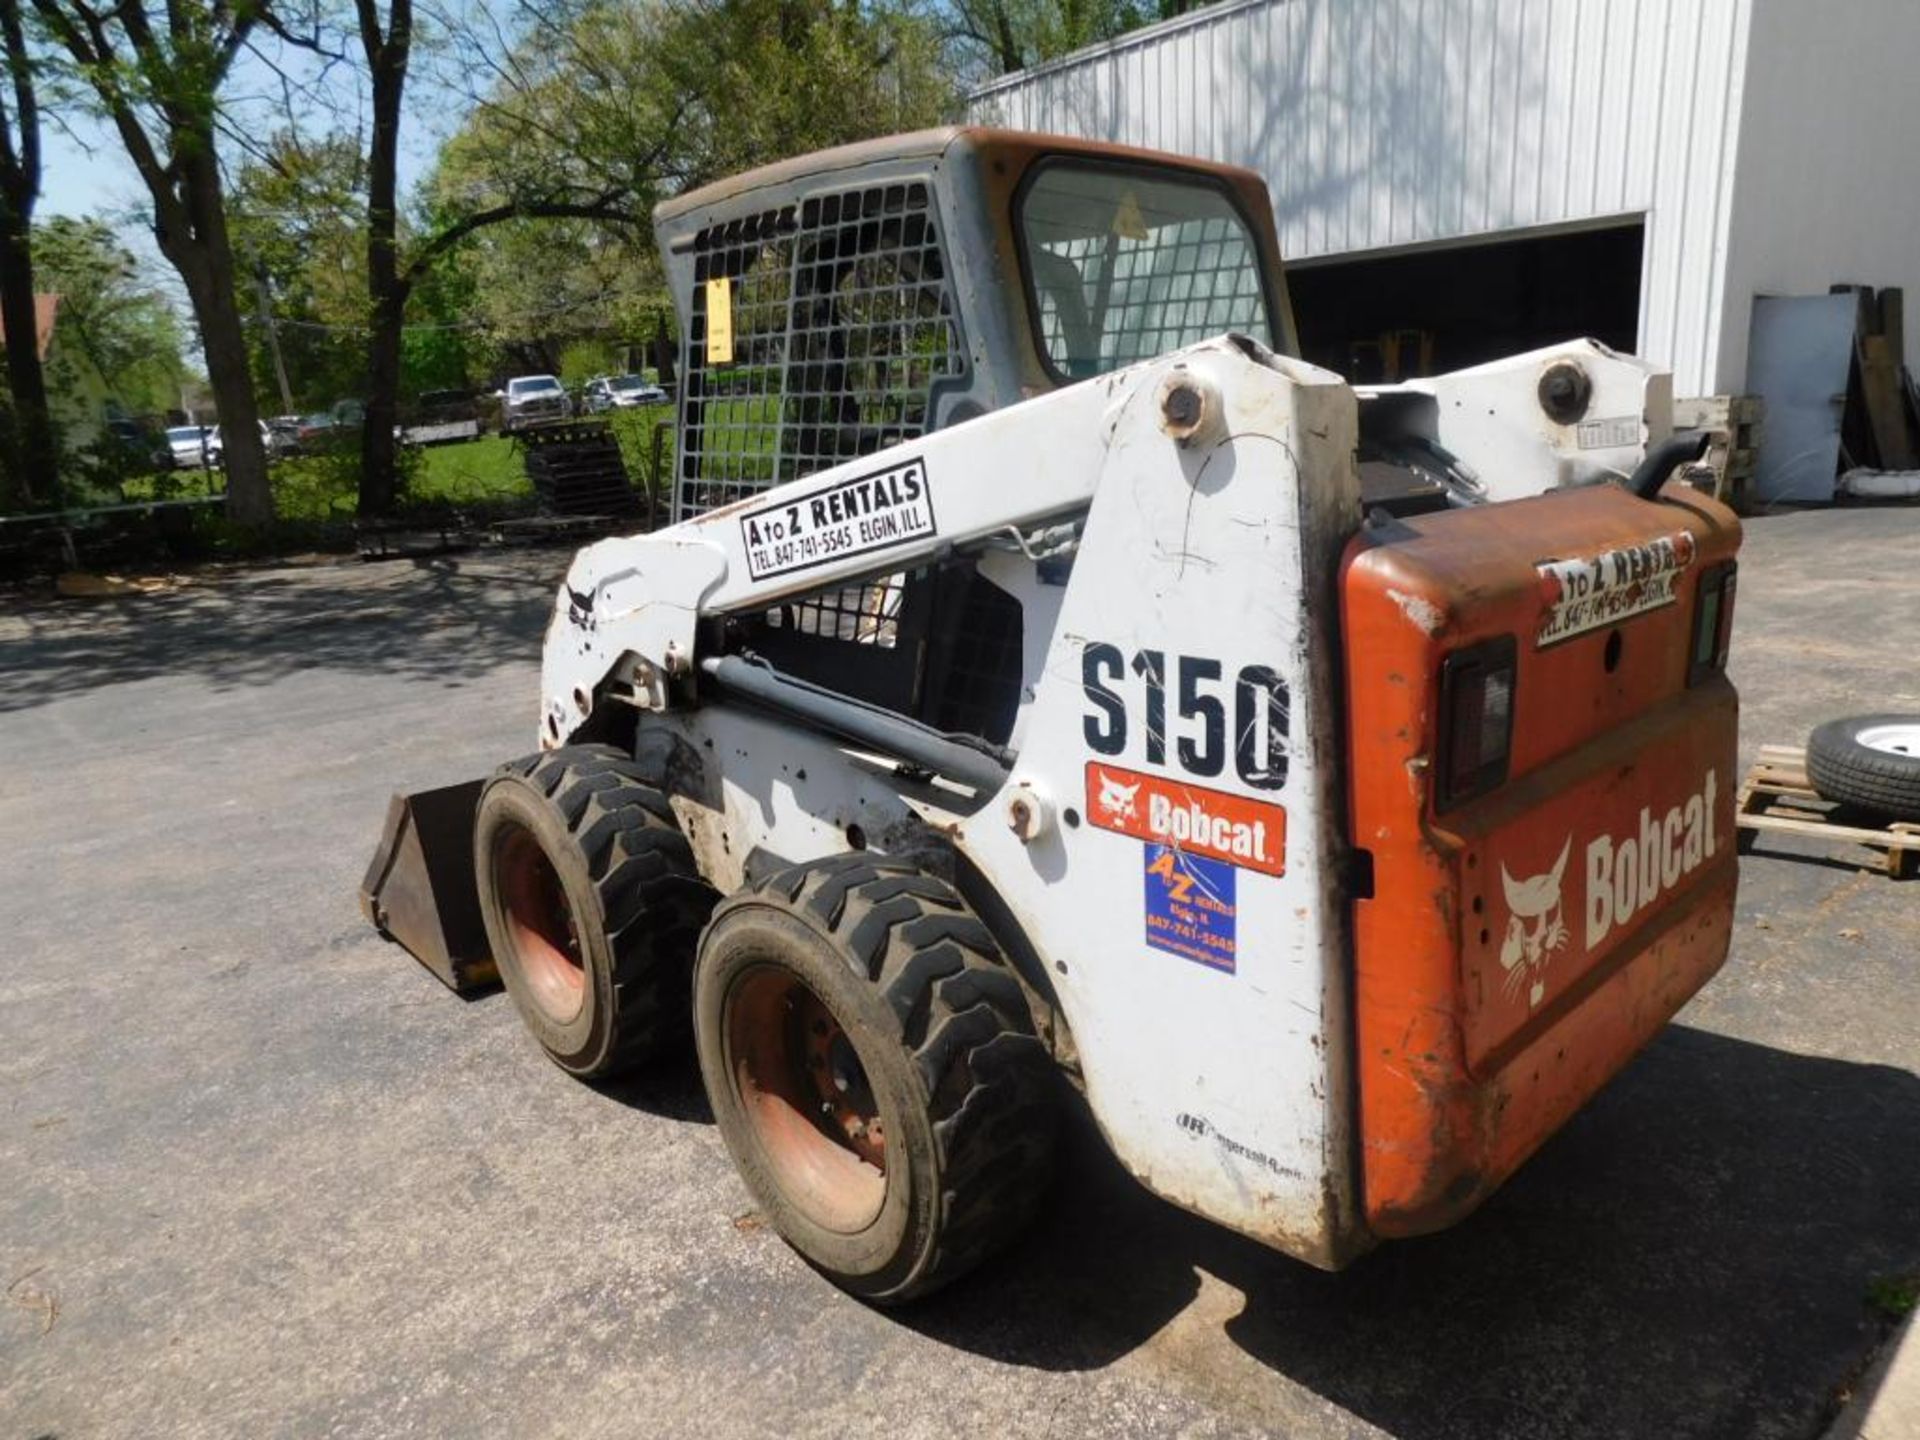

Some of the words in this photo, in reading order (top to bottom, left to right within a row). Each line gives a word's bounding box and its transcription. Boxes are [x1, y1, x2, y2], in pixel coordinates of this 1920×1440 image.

[749, 520, 762, 548] A
[763, 521, 785, 542] to
[786, 507, 802, 536] Z
[811, 469, 921, 529] RENTALS
[1082, 641, 1291, 791] S150
[1149, 793, 1266, 862] Bobcat
[1586, 768, 1717, 952] Bobcat
[1147, 853, 1175, 881] A
[1168, 872, 1195, 904] Z
